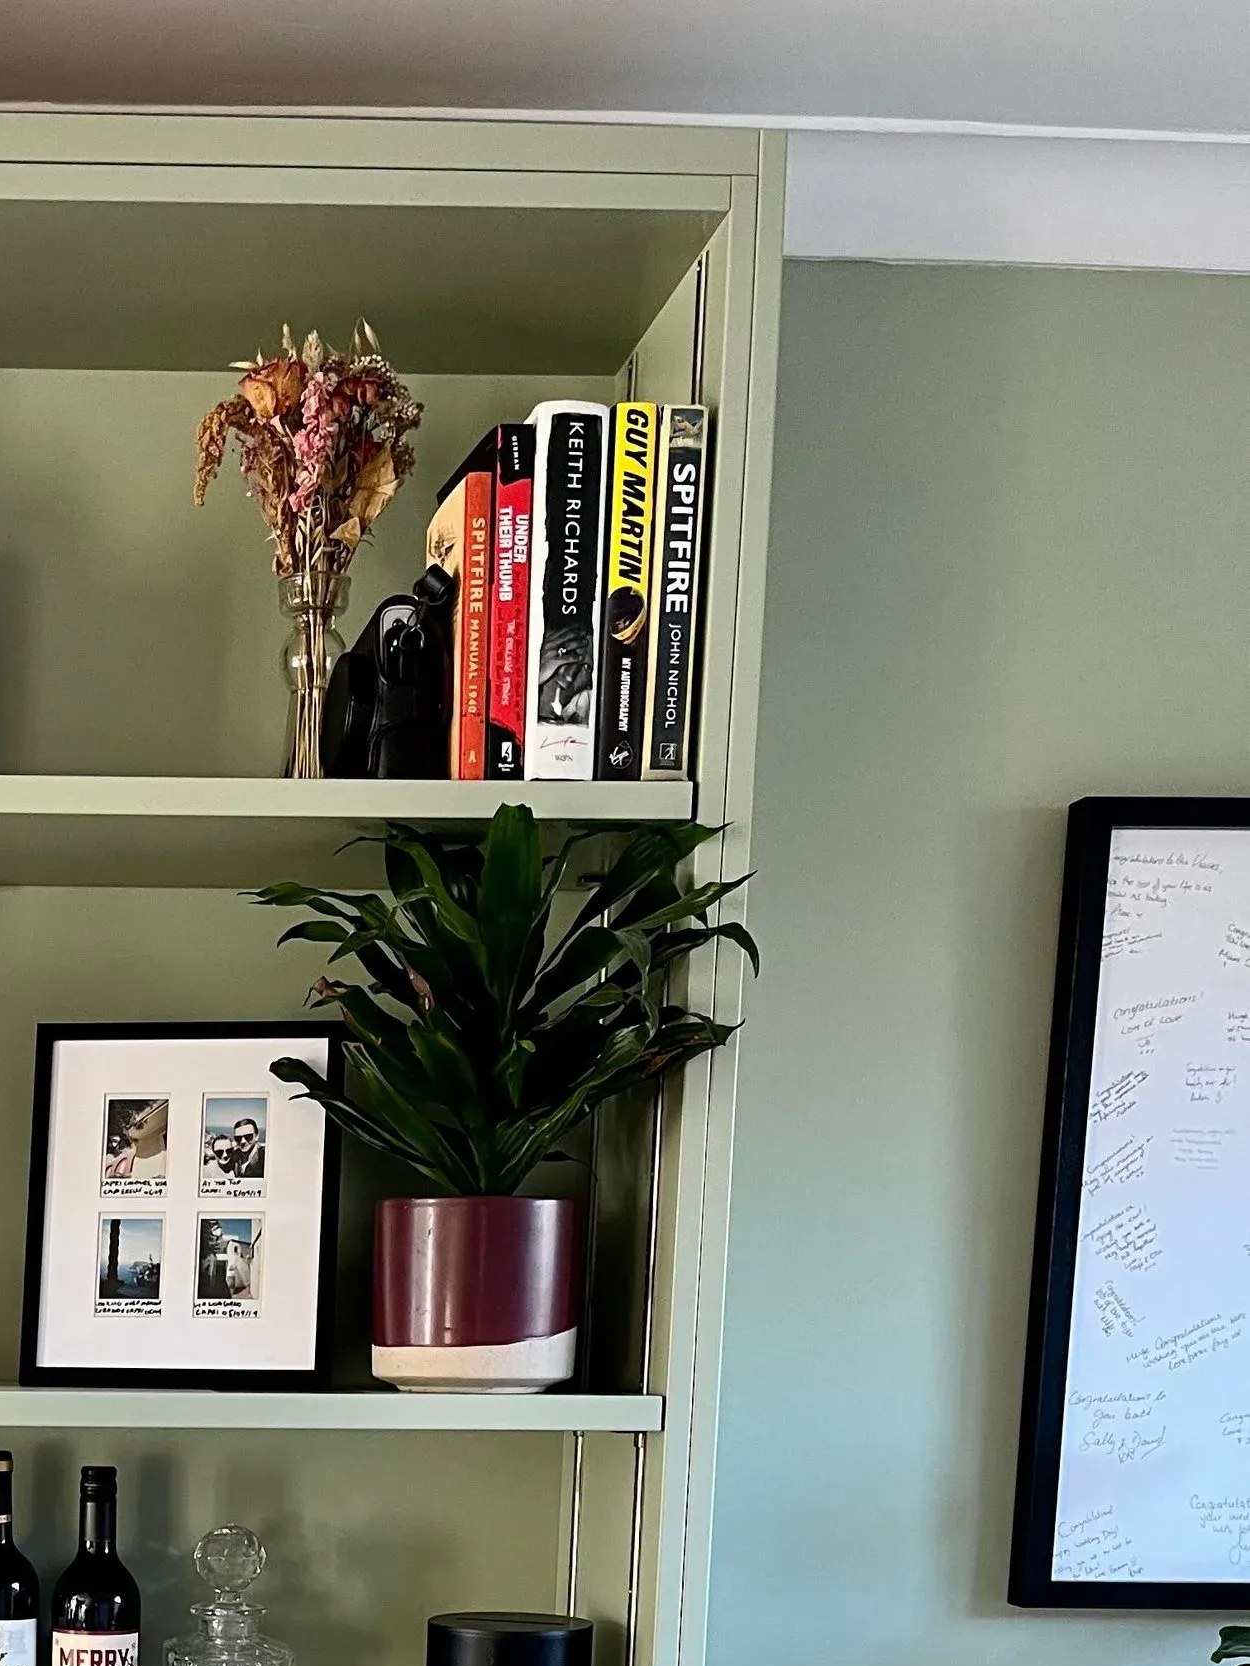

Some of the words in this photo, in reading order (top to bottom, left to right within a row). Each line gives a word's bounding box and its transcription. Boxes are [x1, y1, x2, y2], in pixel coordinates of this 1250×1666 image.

[566, 421, 585, 489] KEITH
[624, 408, 648, 469] GUY
[499, 506, 513, 541] THEIR
[513, 513, 529, 564] UNDER
[618, 472, 644, 584] MARTIN
[665, 462, 697, 614] SPITFIRE
[470, 517, 486, 613] SPITFIRE
[498, 543, 513, 601] THUMB
[561, 499, 582, 615] RICHARDS
[468, 619, 480, 680] MANUAL
[621, 657, 630, 669] MY
[668, 623, 683, 664] JOHN
[467, 685, 478, 714] 1940
[619, 671, 630, 733] AUTOBIOGRAPHY
[664, 668, 680, 729] NICHOL
